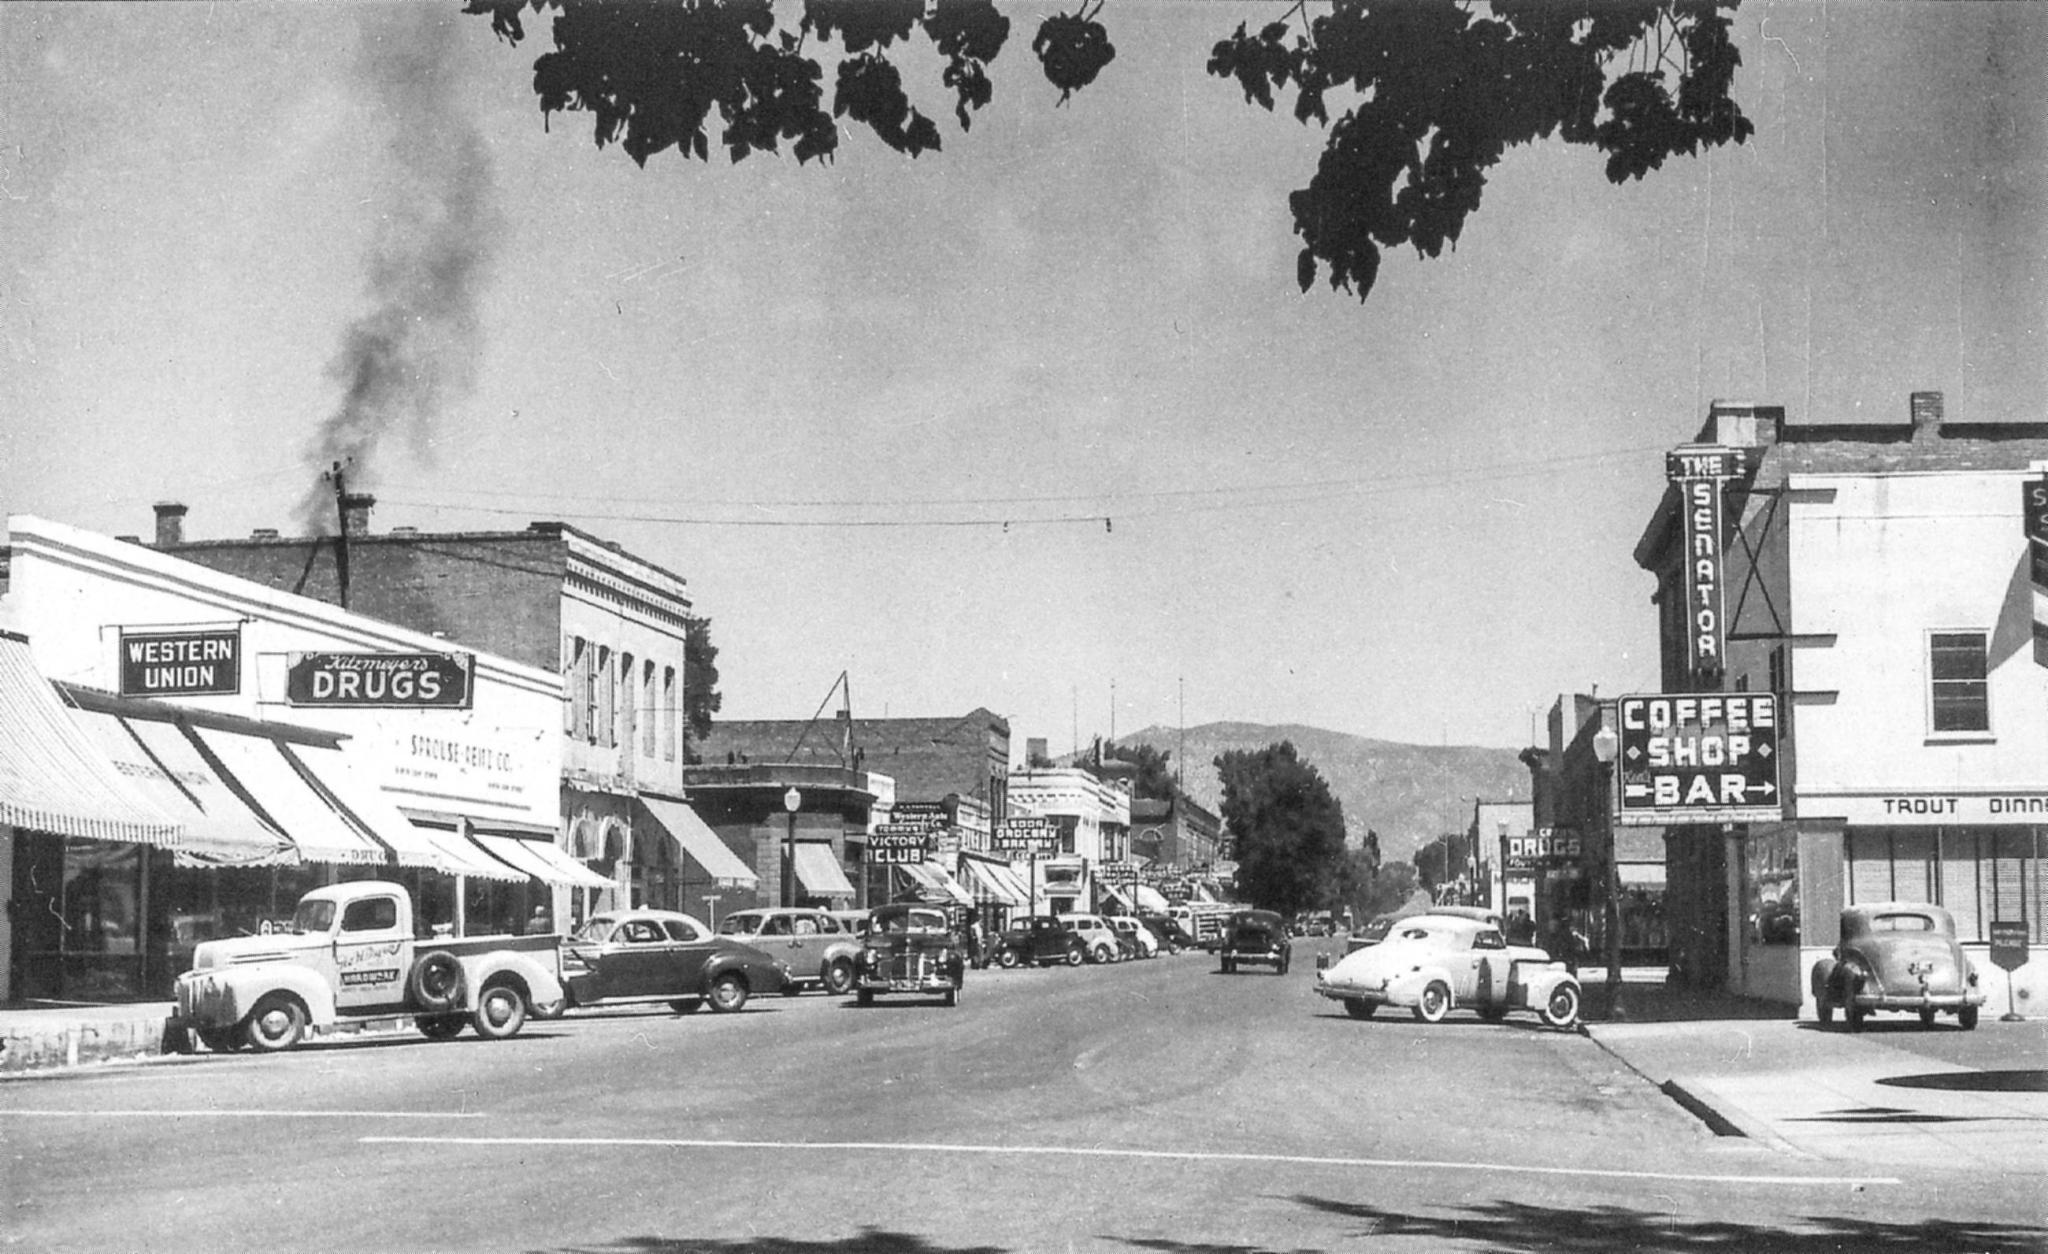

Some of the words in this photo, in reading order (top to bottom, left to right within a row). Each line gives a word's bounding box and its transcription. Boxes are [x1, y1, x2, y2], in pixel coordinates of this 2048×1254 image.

[1681, 456, 1722, 475] THE
[1693, 482, 1717, 658] SENATOR
[129, 639, 232, 663] WESTERN
[145, 665, 214, 688] UNION
[313, 670, 441, 699] DRUGS
[1624, 698, 1774, 730] COFFEE
[1648, 736, 1750, 767] SHOP
[1654, 774, 1747, 805] BAR
[1883, 799, 1958, 814] TROUT
[1989, 799, 2048, 814] DINN
[869, 836, 926, 847] VICTORY
[1002, 839, 1052, 848] BAKRY
[1509, 838, 1581, 856] DRUGS
[875, 849, 921, 863] CLUB
